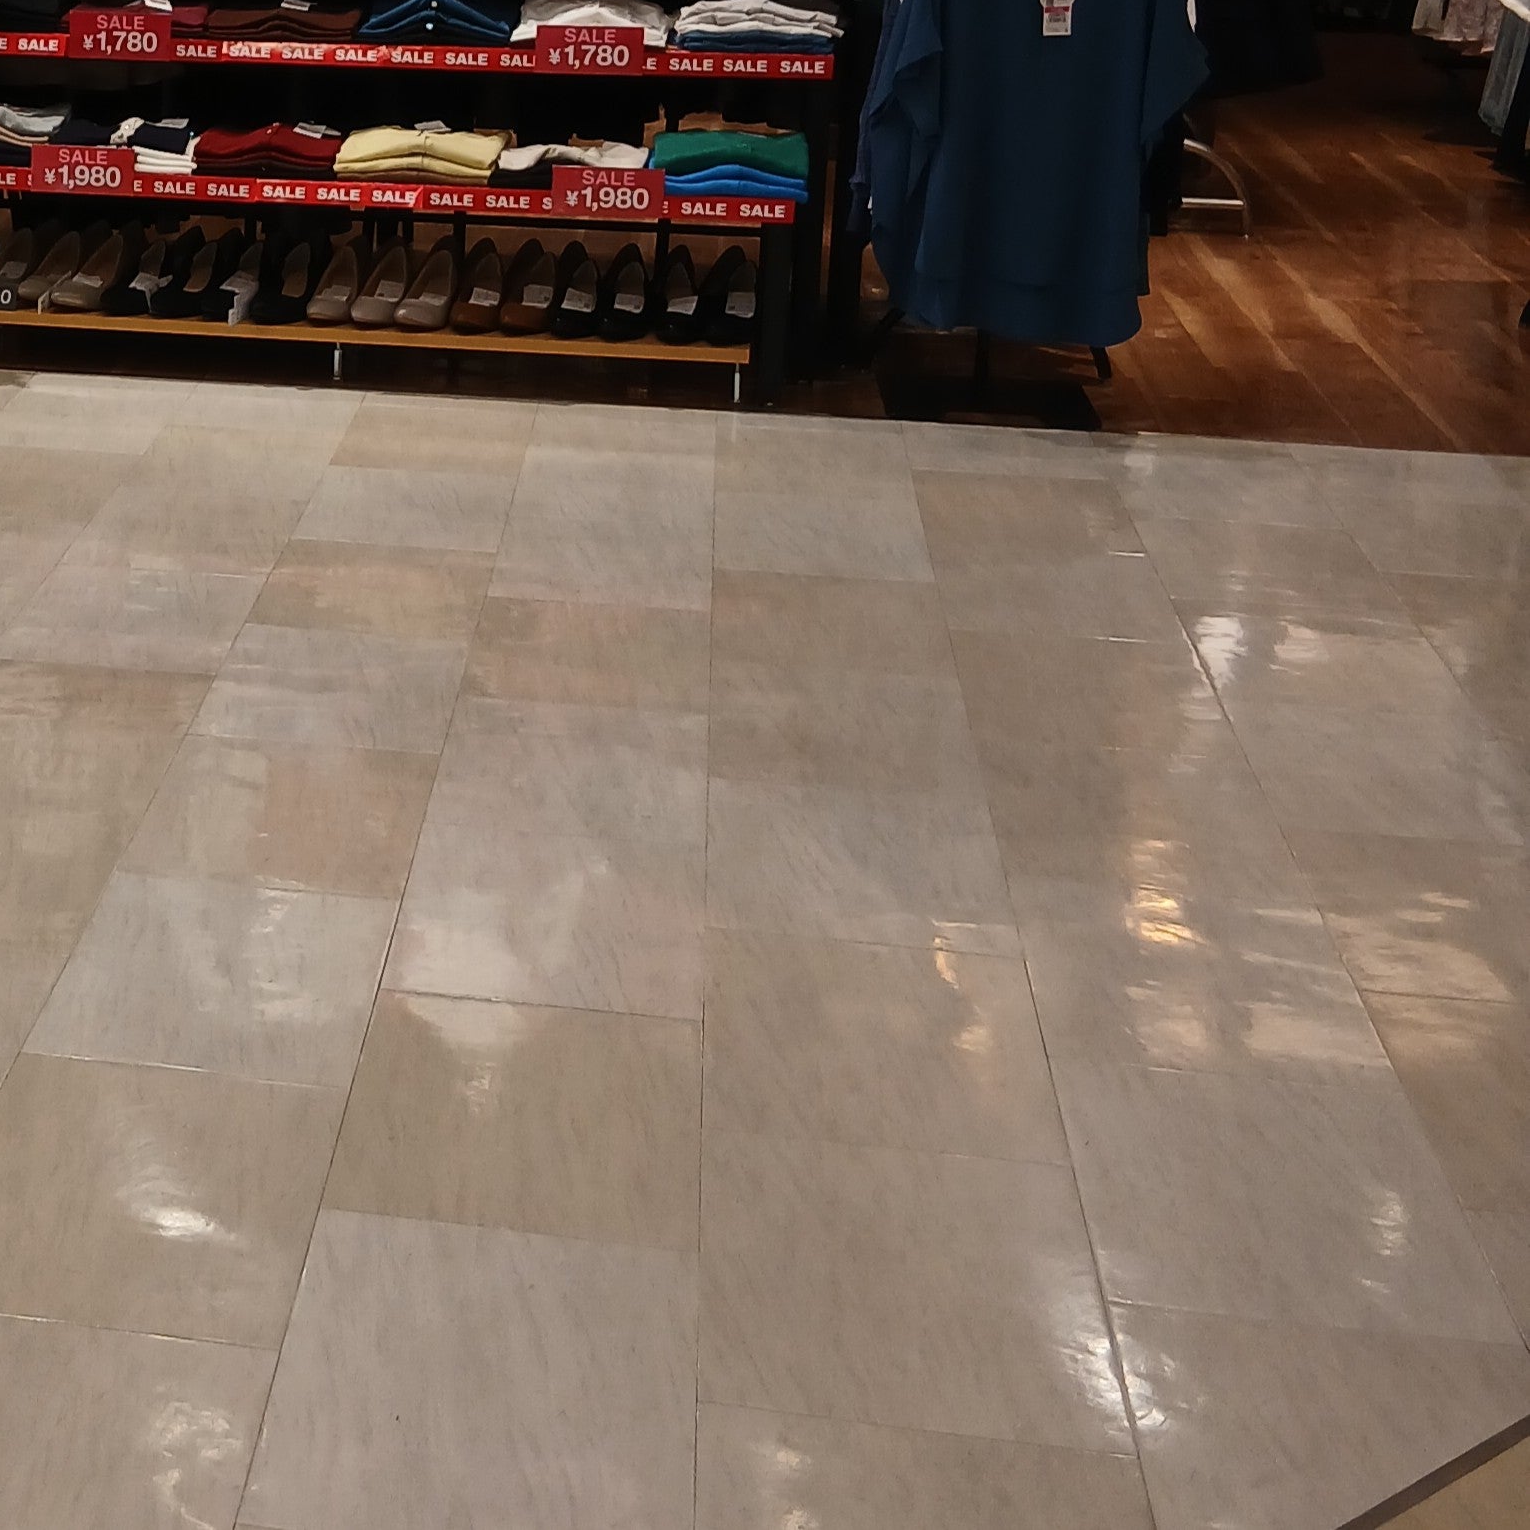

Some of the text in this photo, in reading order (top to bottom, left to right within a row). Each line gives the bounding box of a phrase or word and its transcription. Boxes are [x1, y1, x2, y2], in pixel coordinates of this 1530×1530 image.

[96, 14, 145, 30] SALE
[17, 37, 58, 51] SALE
[82, 30, 158, 55] ¥1,780
[563, 28, 616, 44] SALE
[175, 44, 217, 58] SALE
[228, 44, 270, 58] SALE
[281, 46, 324, 60] SALE
[334, 48, 377, 62] SALE
[391, 50, 434, 64] SALE
[444, 52, 488, 66] SALE
[548, 45, 630, 70] ¥1,780
[669, 57, 714, 72] SALE
[722, 58, 768, 72] SALE
[779, 60, 825, 74] SALE
[57, 149, 108, 164] SALE
[44, 165, 121, 189] ¥1,980
[581, 170, 636, 186] SALE
[153, 181, 196, 195] SALE
[206, 183, 250, 198] SALE
[262, 185, 306, 199] SALE
[316, 187, 360, 201] SALE
[371, 189, 415, 204] SALE
[429, 192, 474, 207] SALE
[485, 194, 530, 209] SALE
[565, 187, 650, 212] ¥1,980
[680, 201, 727, 216] SALE
[739, 203, 785, 218] SALE
